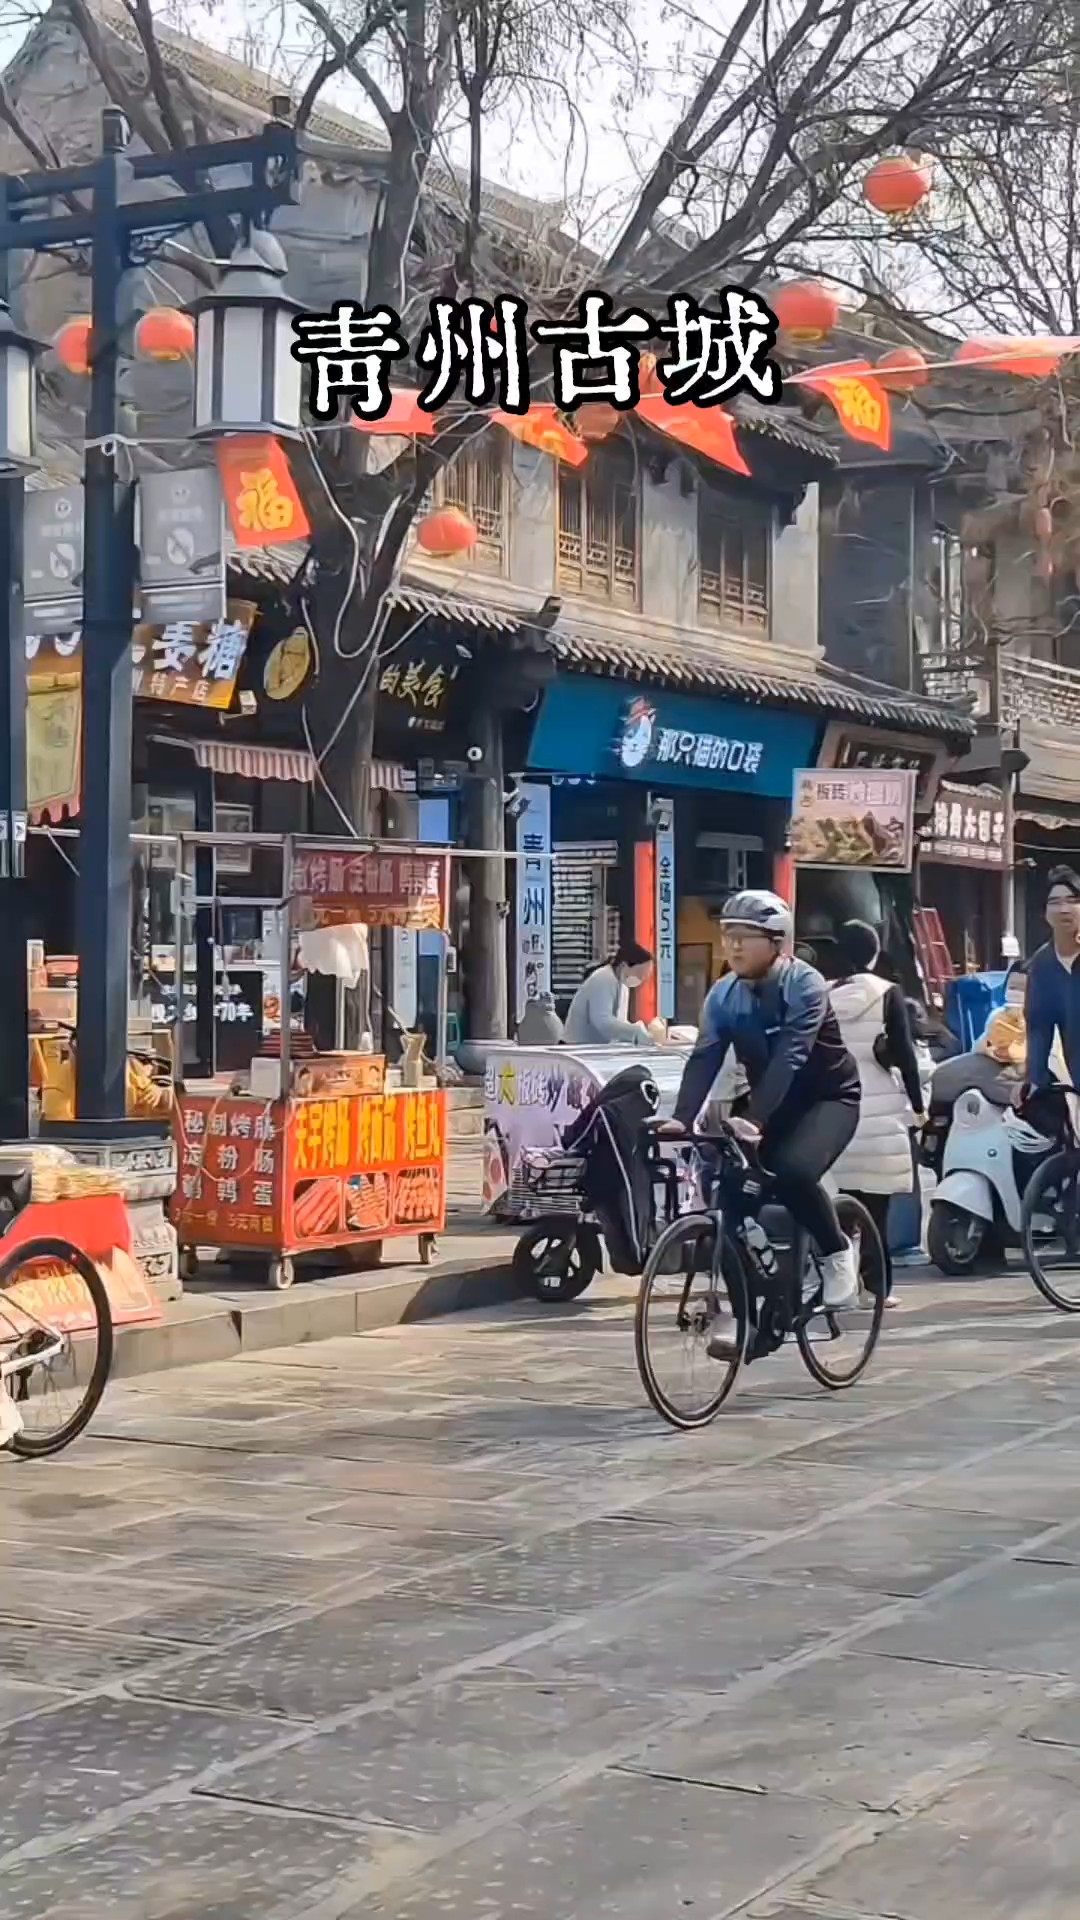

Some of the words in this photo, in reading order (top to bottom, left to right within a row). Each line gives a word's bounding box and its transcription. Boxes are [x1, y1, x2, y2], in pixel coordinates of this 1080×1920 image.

[238, 467, 293, 532] 福
[656, 727, 764, 774] 那只猫的口袋
